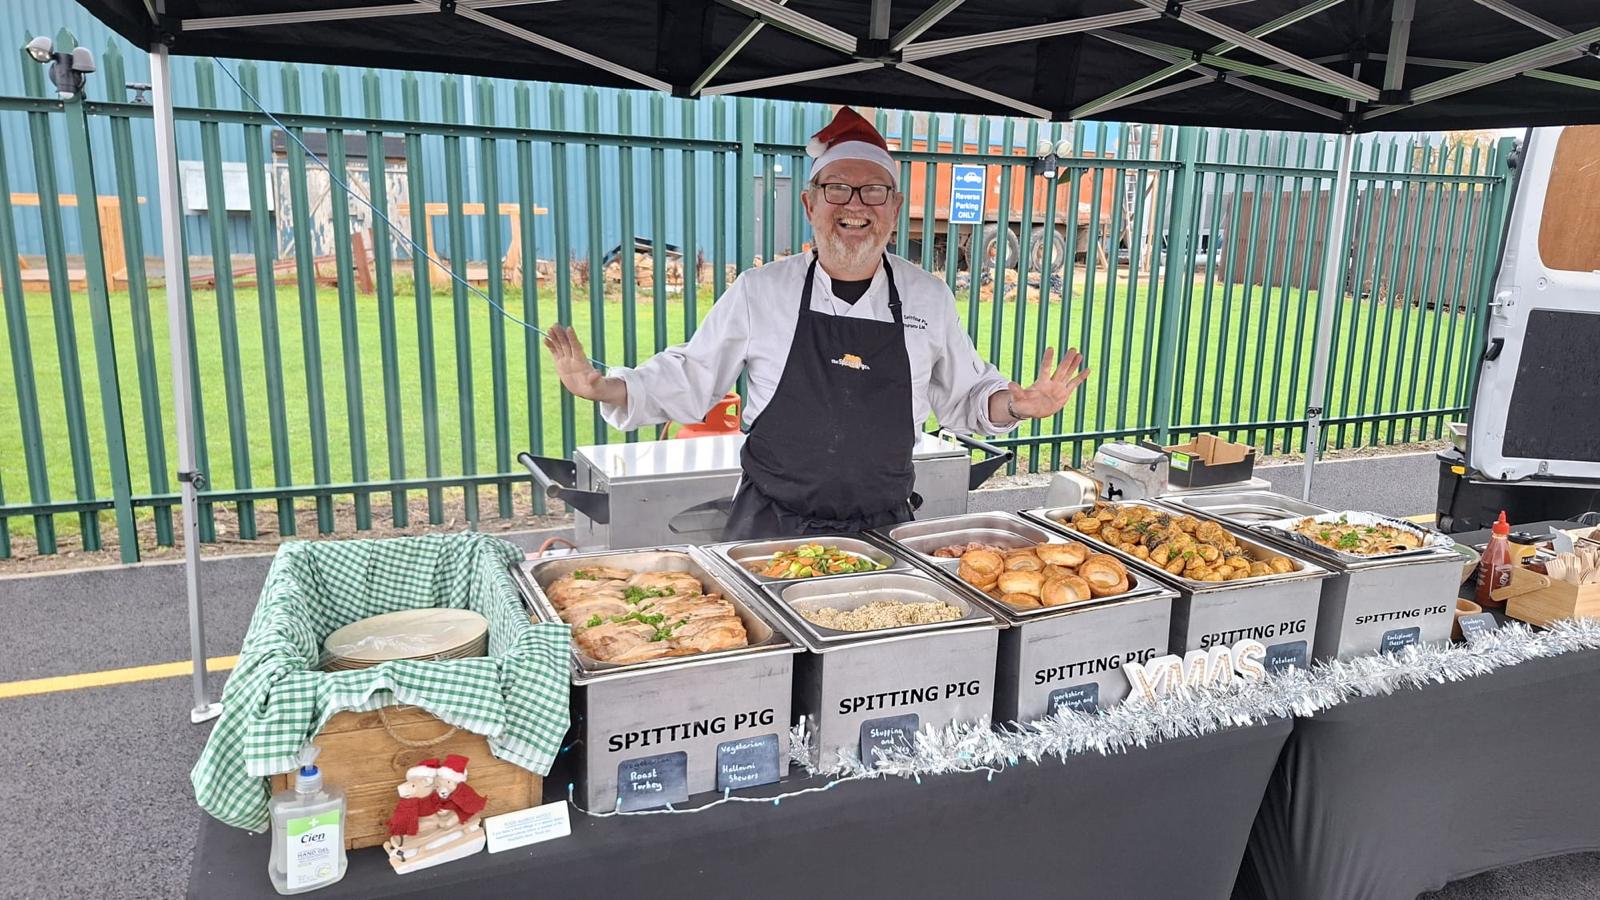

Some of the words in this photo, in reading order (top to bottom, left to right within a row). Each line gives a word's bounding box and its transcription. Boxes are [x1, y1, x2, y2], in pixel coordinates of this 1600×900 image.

[955, 192, 980, 200] Reverse
[955, 202, 979, 211] Parking
[1355, 608, 1420, 624] SPITTING
[1424, 605, 1447, 616] PIG
[1200, 625, 1275, 648] SPITTING
[1279, 619, 1307, 635] PIG
[1035, 655, 1120, 685] SPITTING
[1126, 648, 1156, 665] PIG
[1122, 638, 1267, 706] XMAS
[838, 686, 939, 714] SPITTING
[945, 680, 980, 699] PIG
[608, 717, 726, 752] SPITTING
[734, 709, 774, 730] PIG
[870, 727, 904, 739] Stuffing
[881, 737, 894, 745] and
[630, 768, 657, 781] Roast
[722, 763, 755, 774] Halloumi
[729, 772, 759, 783] Skewers
[632, 781, 662, 791] Turkey
[300, 832, 326, 844] Cien
